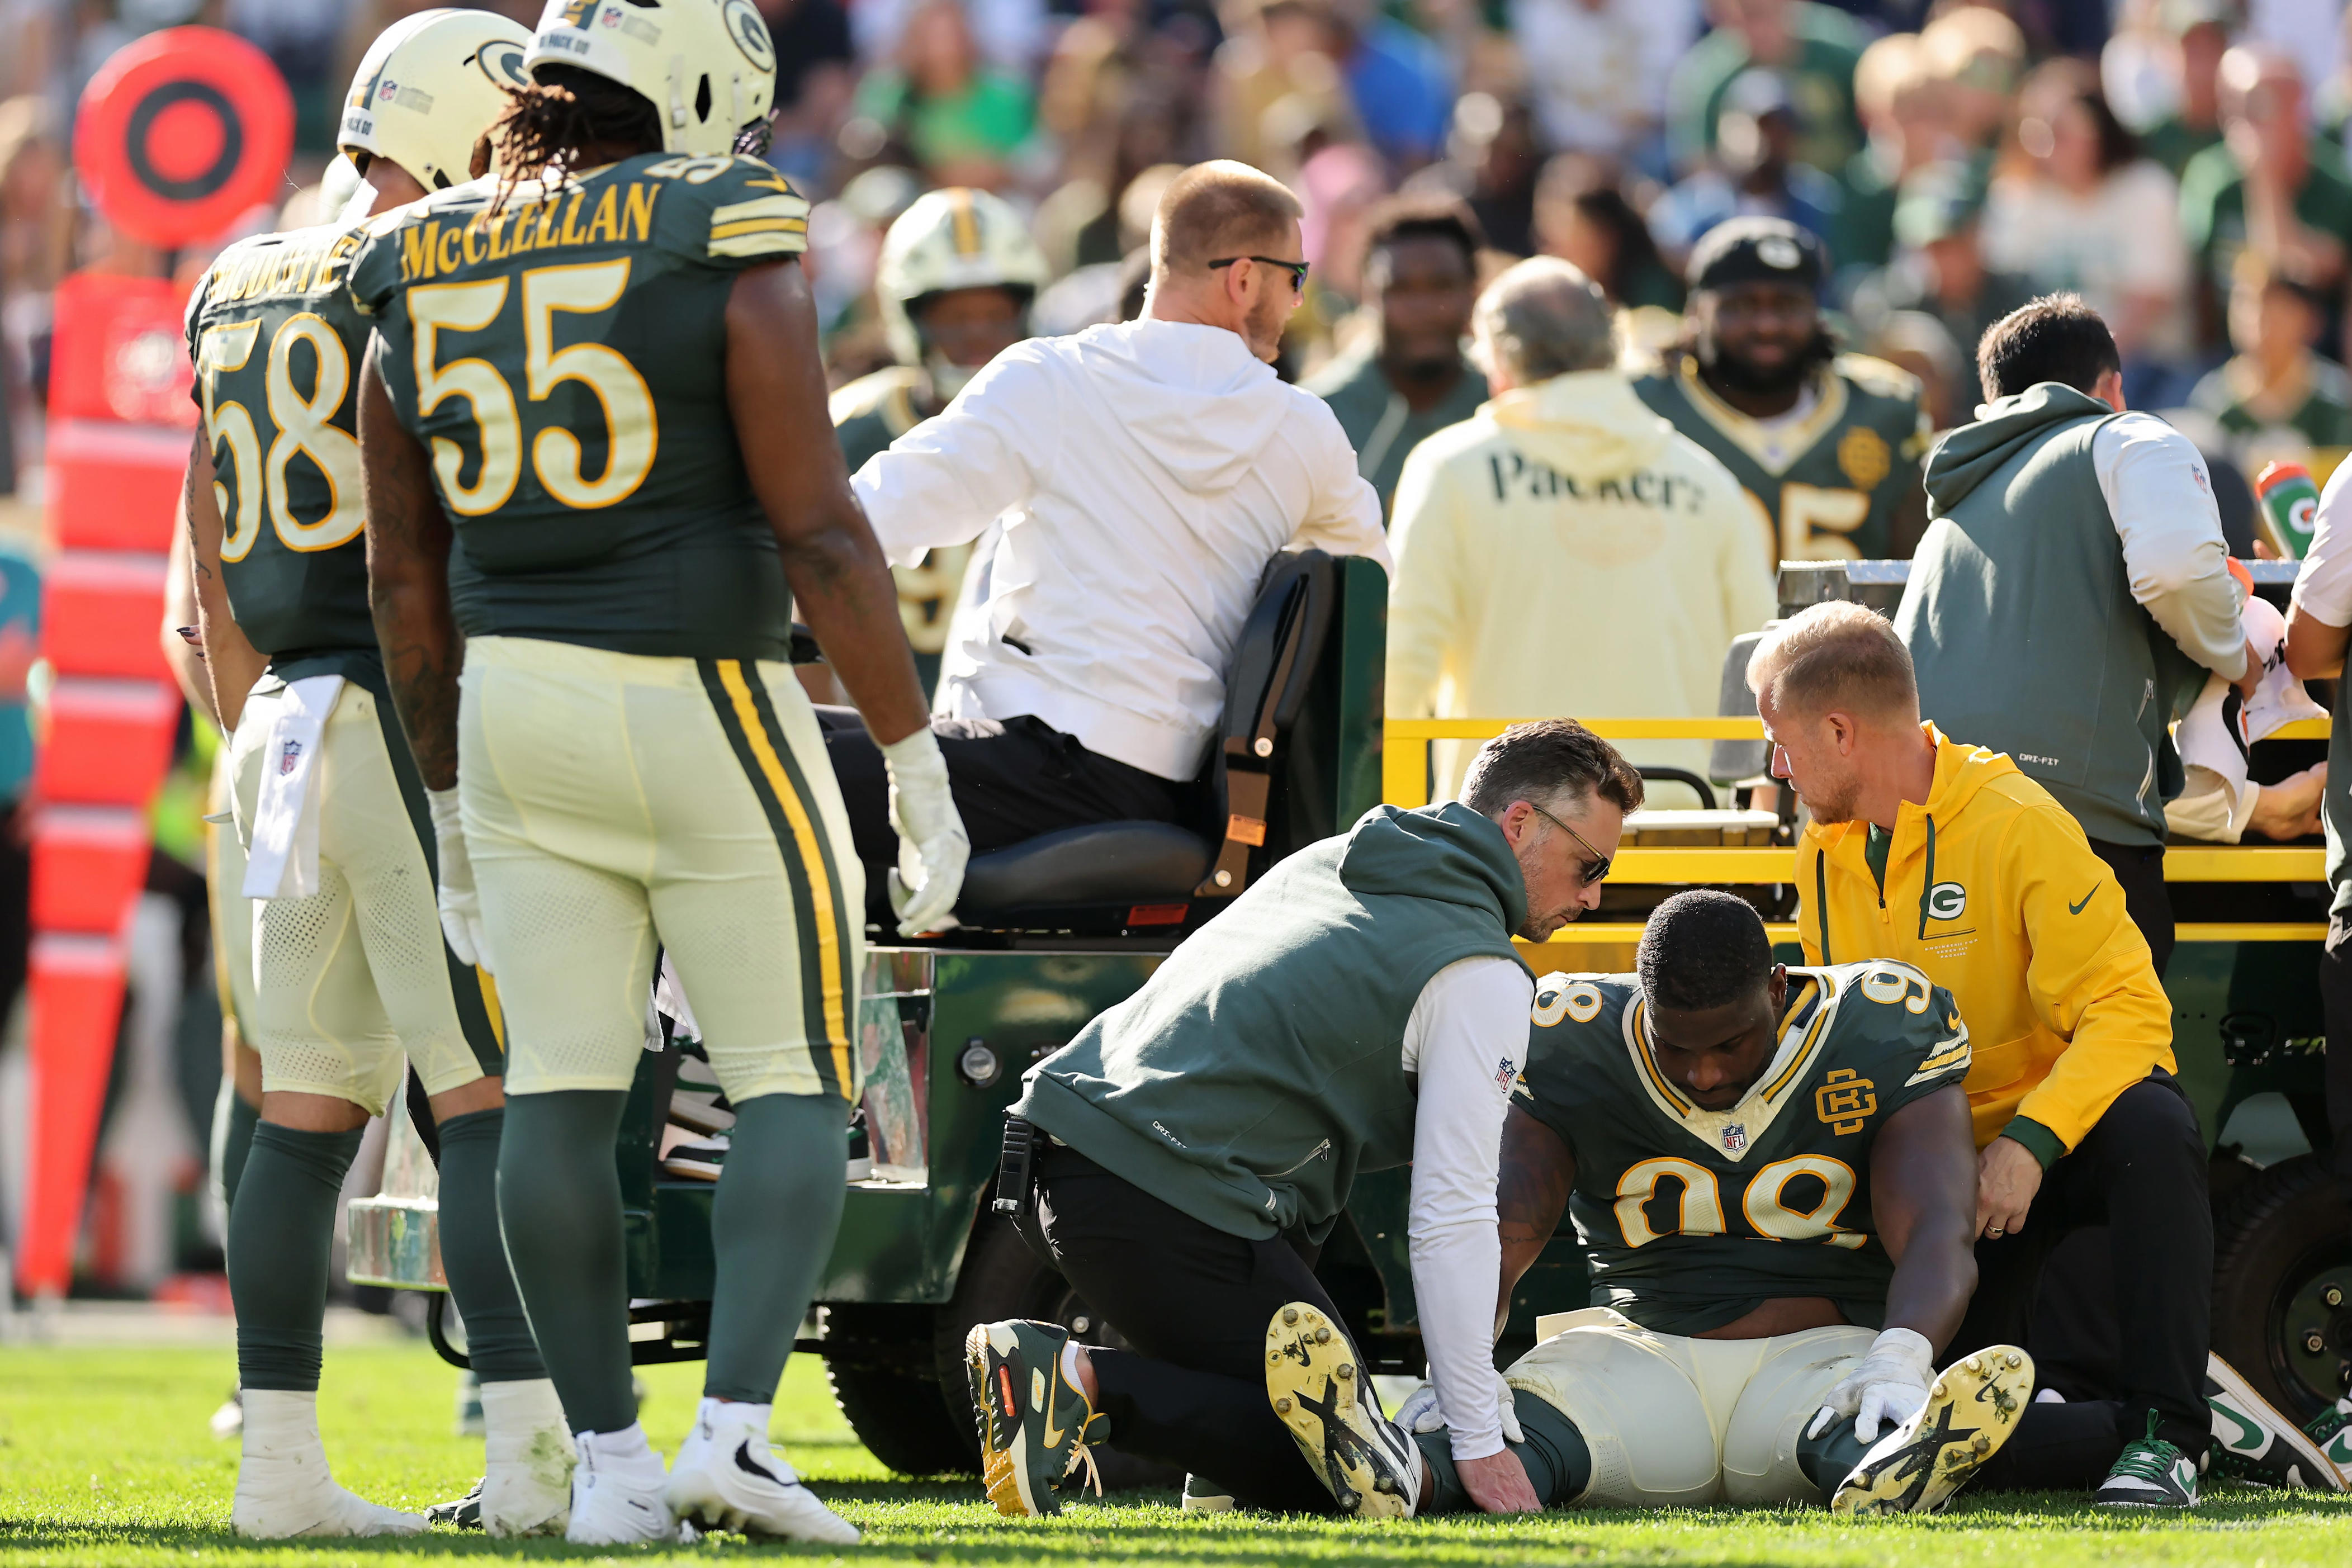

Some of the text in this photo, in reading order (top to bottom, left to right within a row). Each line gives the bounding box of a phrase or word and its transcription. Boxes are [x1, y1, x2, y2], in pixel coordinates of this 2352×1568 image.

[400, 182, 662, 282] McCLELLAN
[406, 257, 659, 517] 55
[198, 312, 367, 563] 58
[2019, 752, 2059, 766] DRI-FIT
[1928, 882, 1966, 921] G
[1152, 1120, 1187, 1149] DRI-FIT
[1725, 1135, 1744, 1149] NFL
